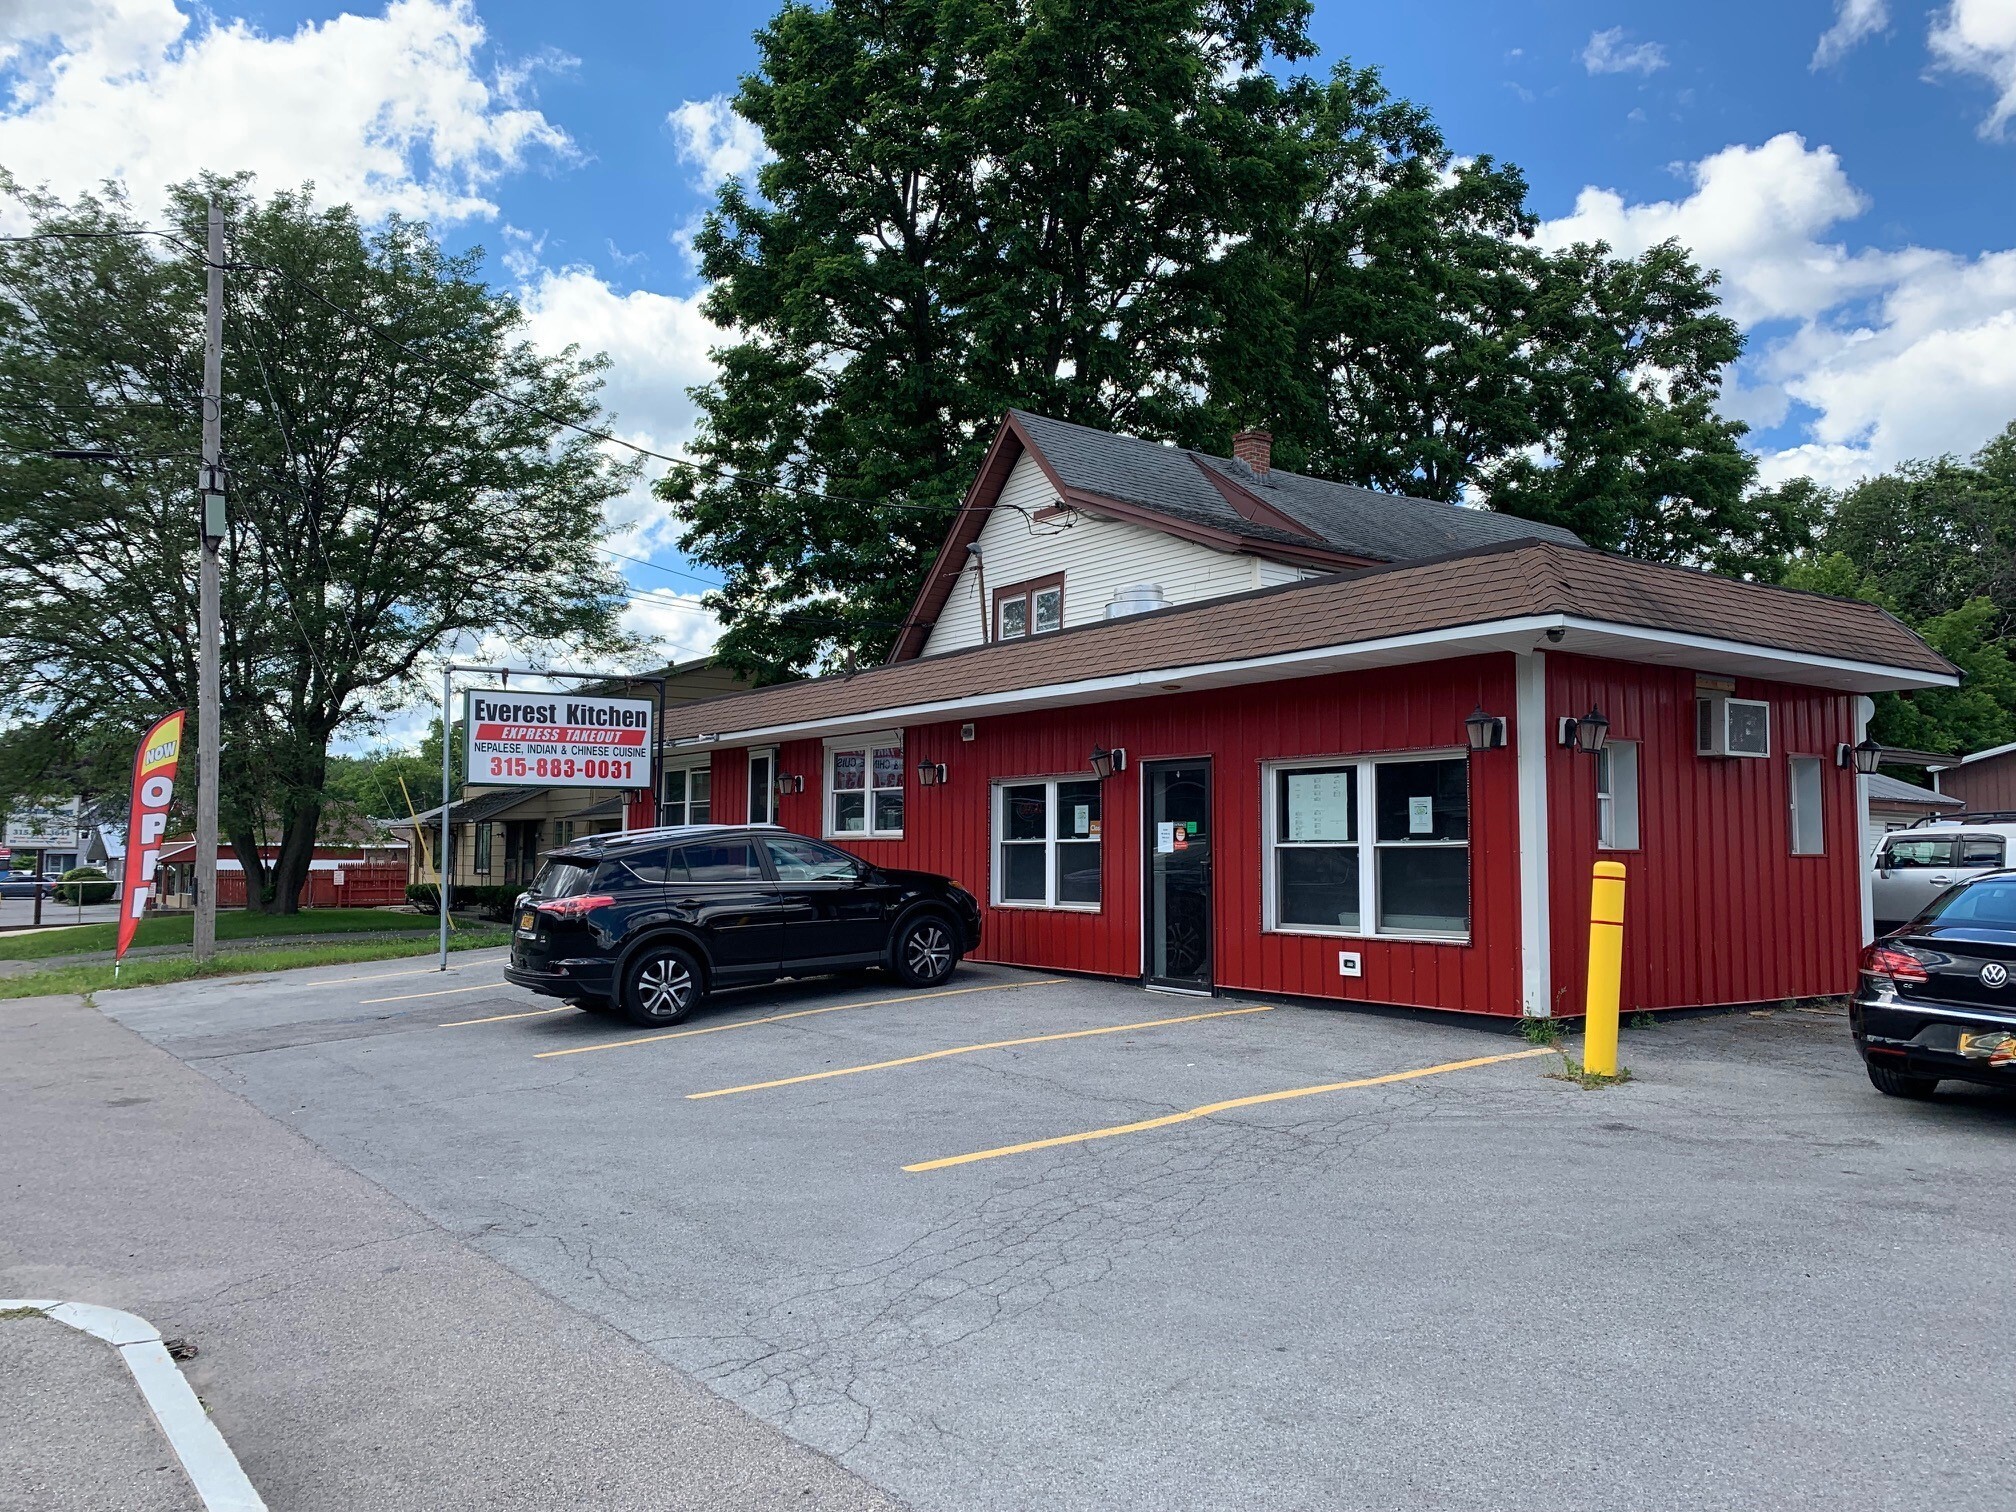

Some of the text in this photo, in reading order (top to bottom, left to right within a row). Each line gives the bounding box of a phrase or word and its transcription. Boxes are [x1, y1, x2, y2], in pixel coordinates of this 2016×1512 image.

[475, 699, 647, 727] Everest Kitchen
[501, 727, 622, 743] EXPRESS TAKEOUT
[145, 740, 176, 765] NOW
[474, 742, 646, 757] NEPALESE, INDIAN & CHINESE CUISINE
[490, 757, 631, 779] 315-883-0031
[132, 775, 174, 919] OP
